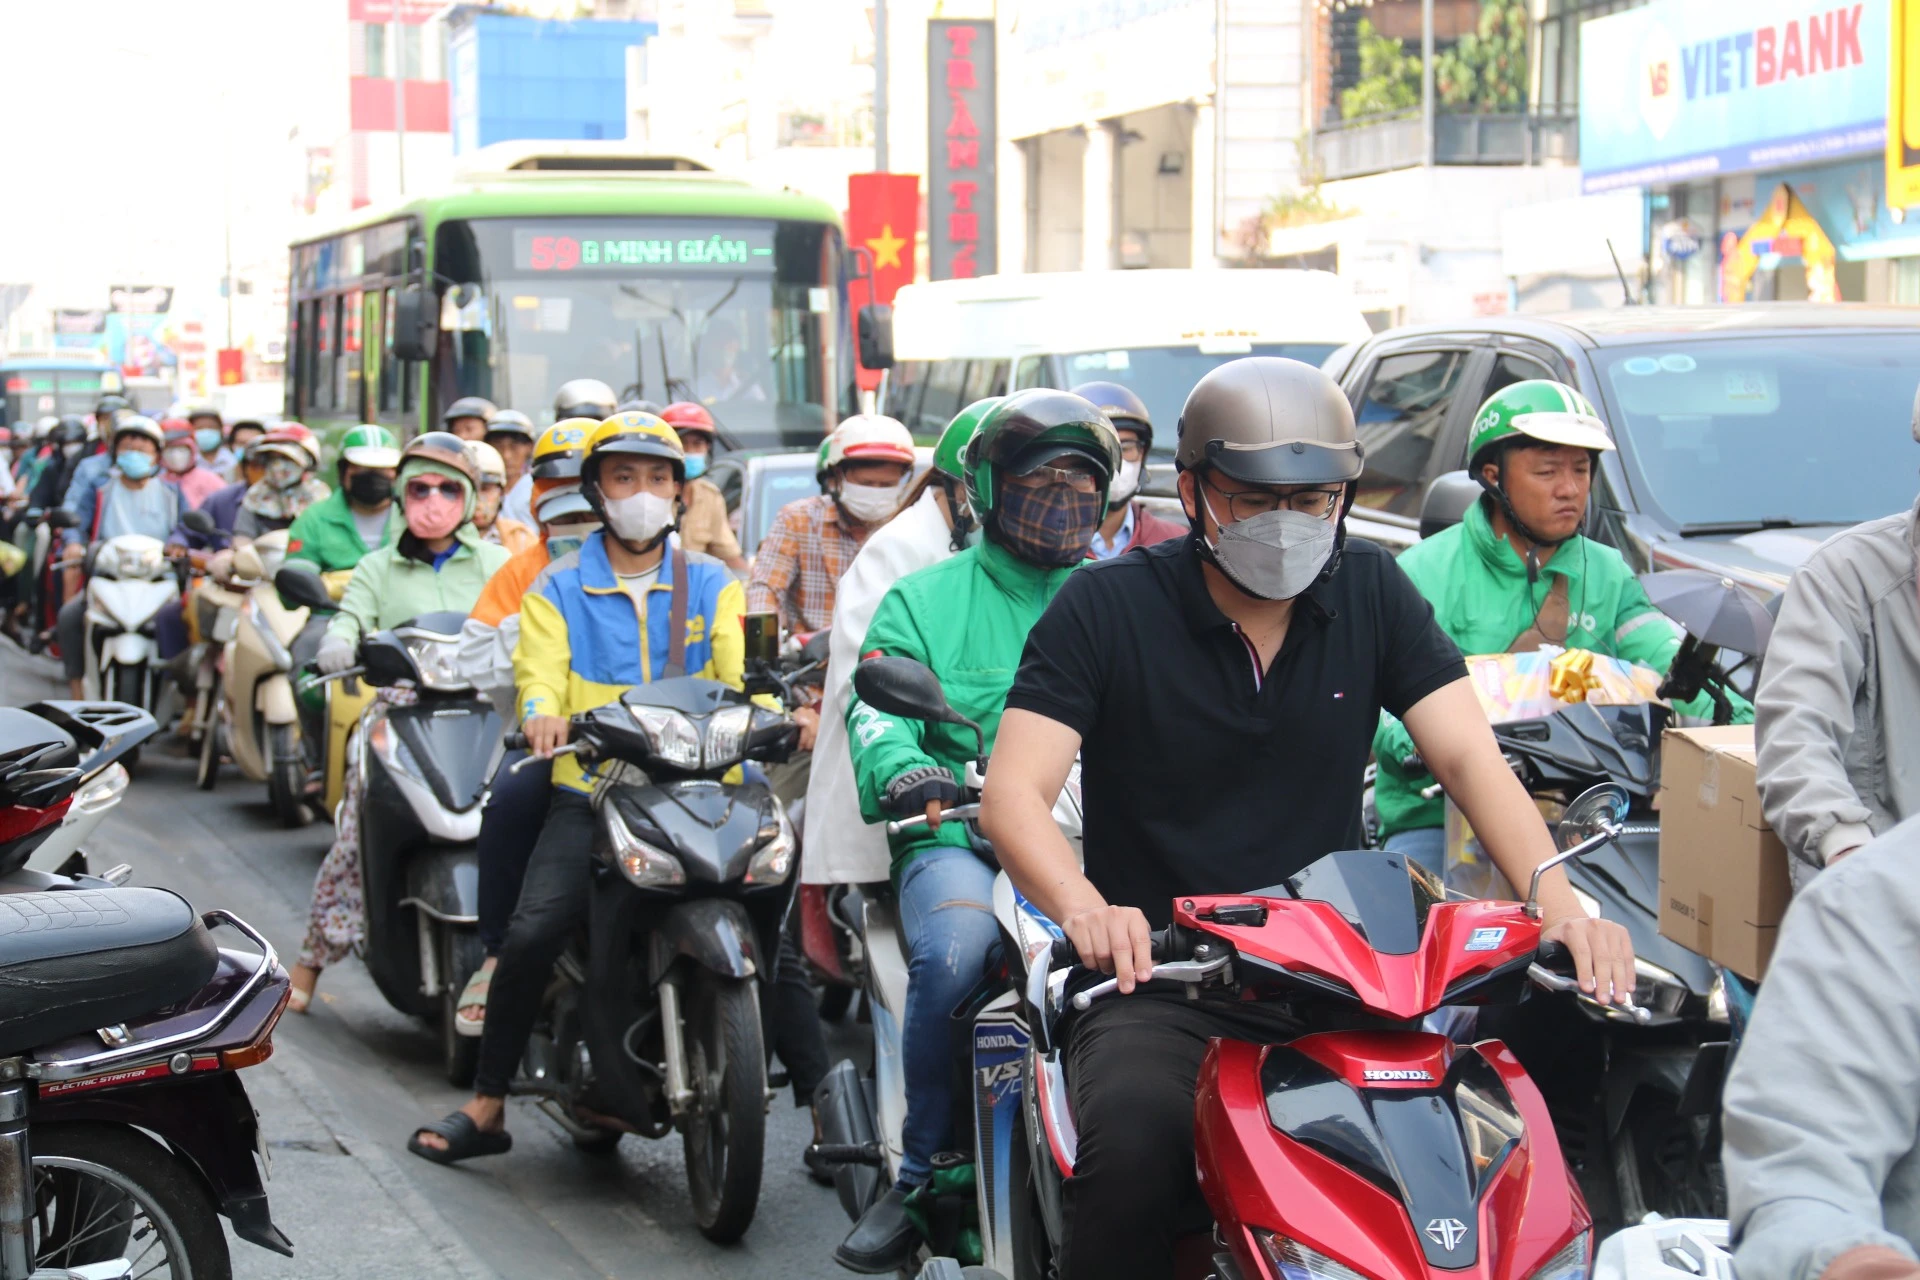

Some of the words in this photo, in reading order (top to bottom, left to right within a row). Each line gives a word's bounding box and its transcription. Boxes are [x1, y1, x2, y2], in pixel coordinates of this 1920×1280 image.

[1681, 4, 1863, 101] VIETBANK
[531, 236, 579, 270] 59
[604, 240, 673, 264] MINH
[976, 1034, 1019, 1049] HONDA
[49, 1079, 97, 1092] ELECTRIC
[99, 1070, 146, 1083] STARTER
[1363, 1070, 1435, 1080] HONDA
